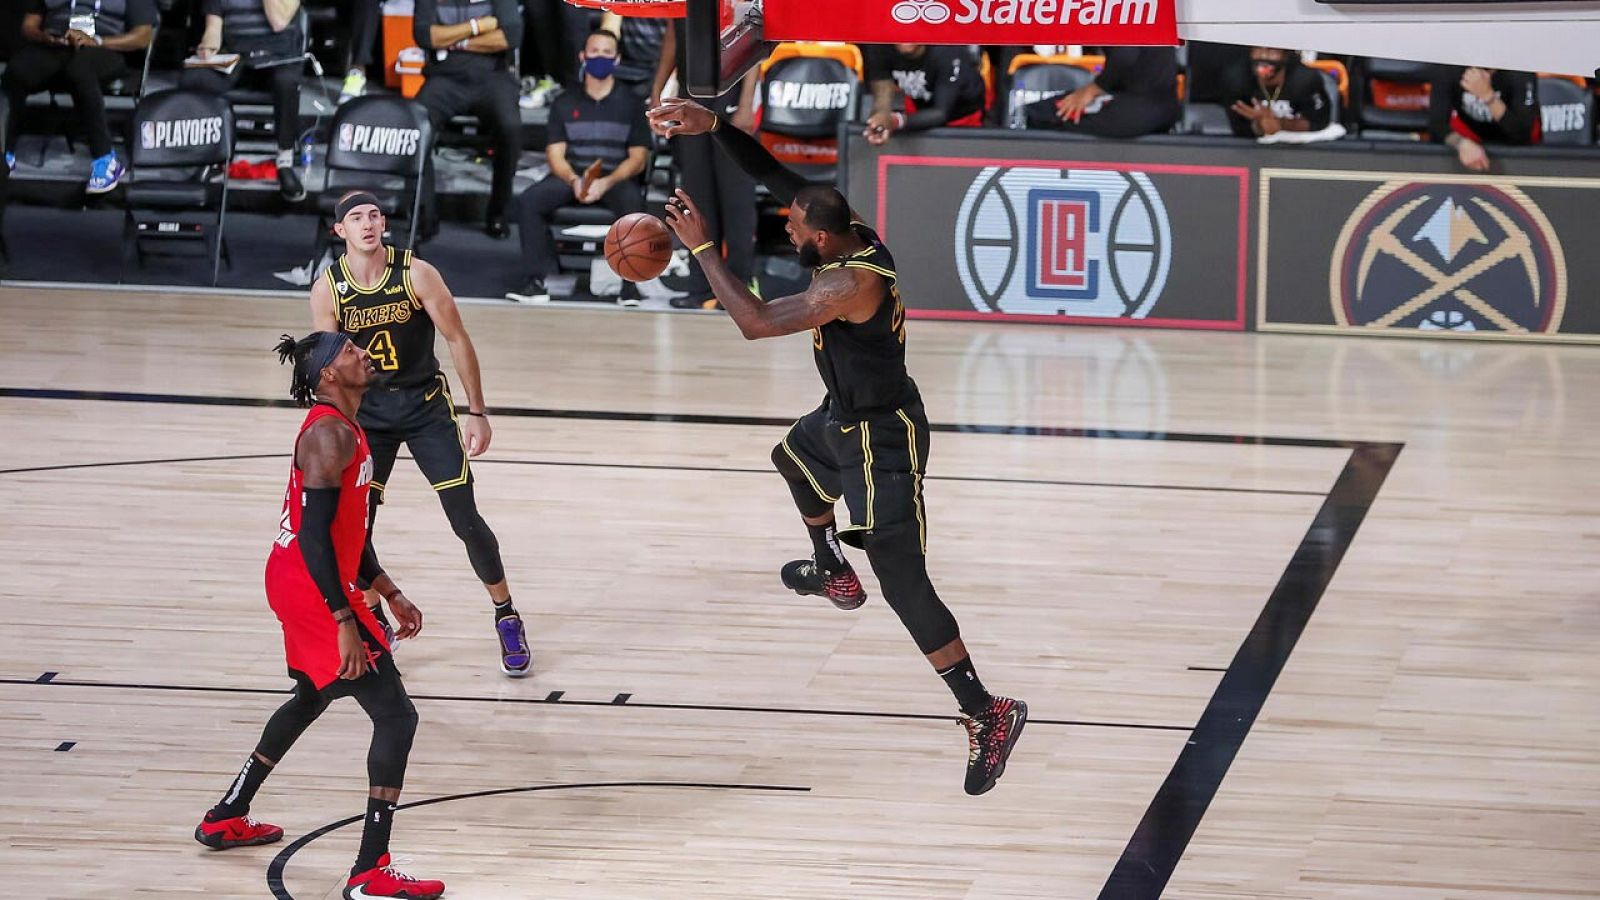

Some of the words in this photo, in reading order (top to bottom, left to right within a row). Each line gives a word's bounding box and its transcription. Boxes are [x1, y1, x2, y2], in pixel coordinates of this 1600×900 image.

[783, 82, 851, 109] PLAYOFFS
[156, 116, 223, 148] PLAYOFFS
[1541, 103, 1586, 133] YOFFS
[352, 125, 421, 156] PLAYOFFS
[344, 300, 412, 333] LAKERS
[366, 330, 400, 371] 4
